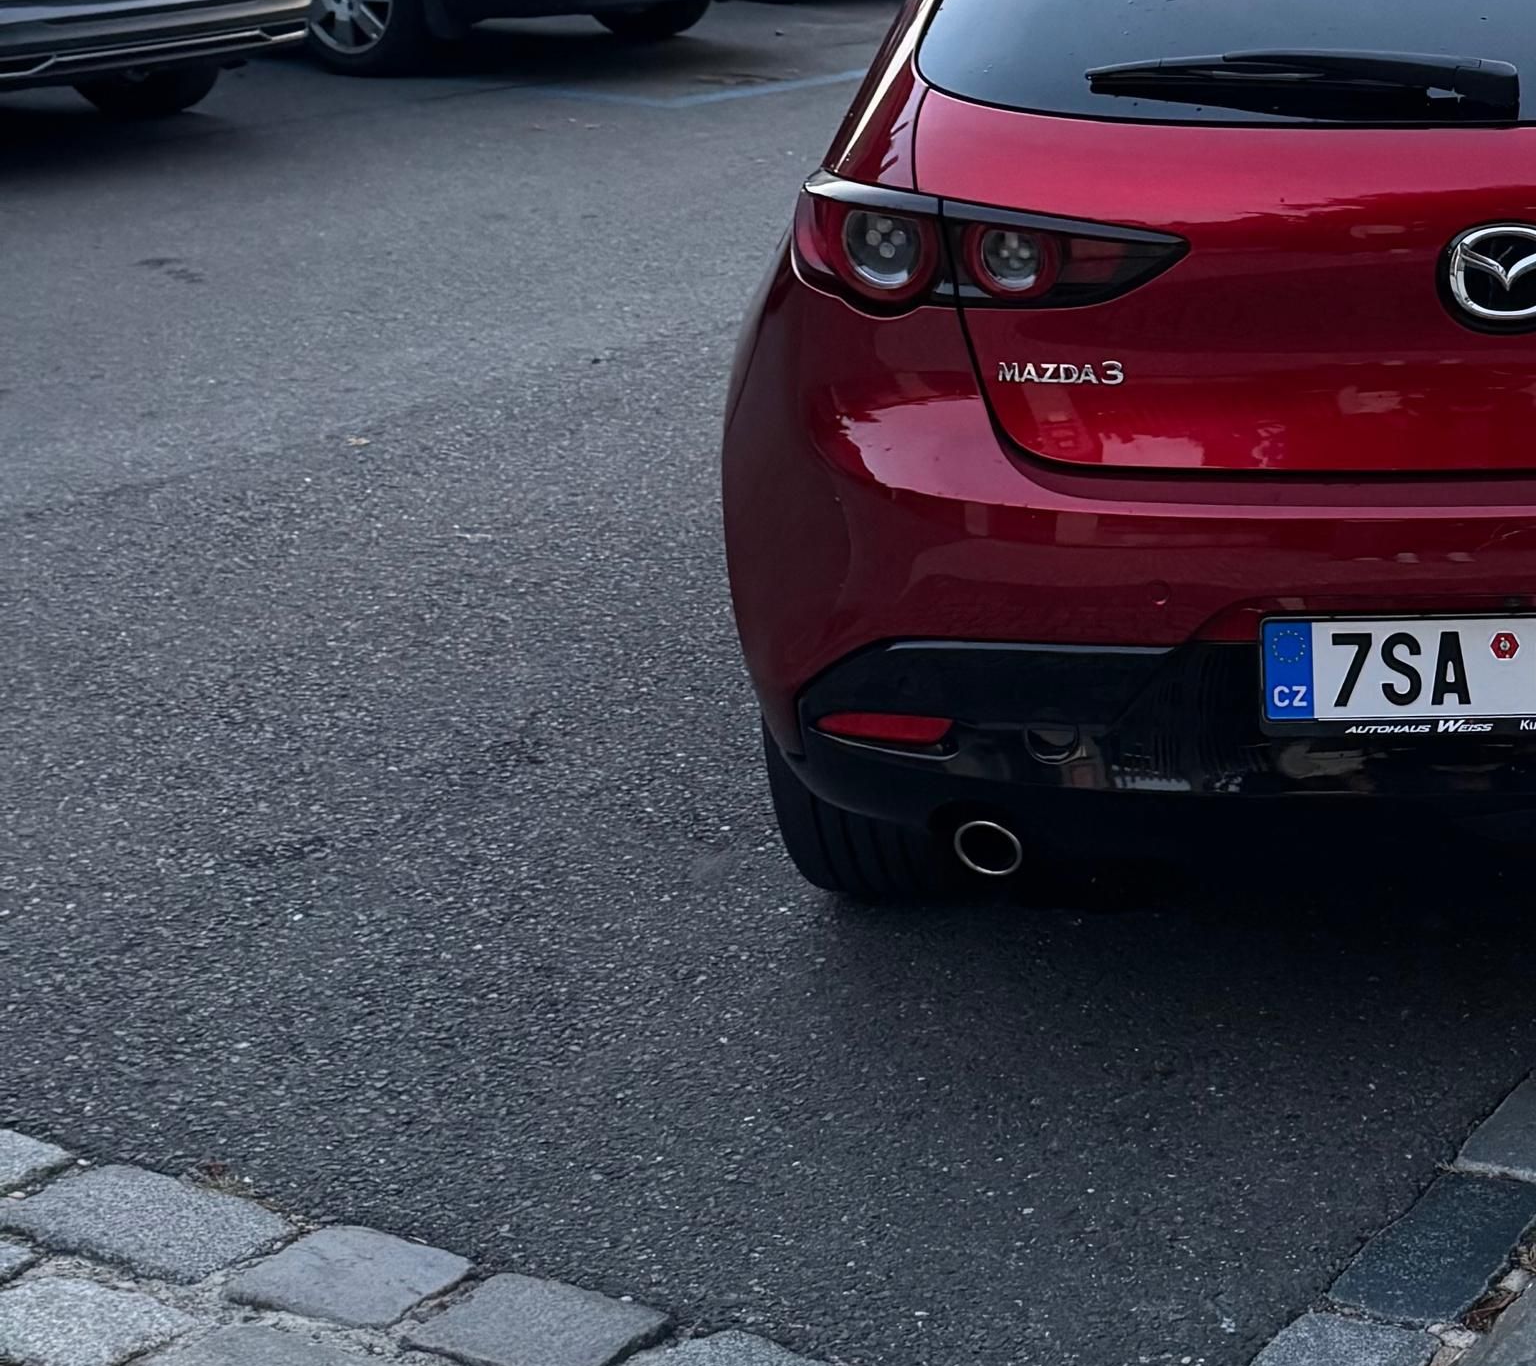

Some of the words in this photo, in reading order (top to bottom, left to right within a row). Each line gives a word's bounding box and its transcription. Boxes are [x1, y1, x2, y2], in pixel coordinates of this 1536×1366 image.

[1331, 631, 1472, 708] 7SA
[1273, 685, 1307, 707] CZ
[1345, 725, 1431, 734] AUTOHAUS
